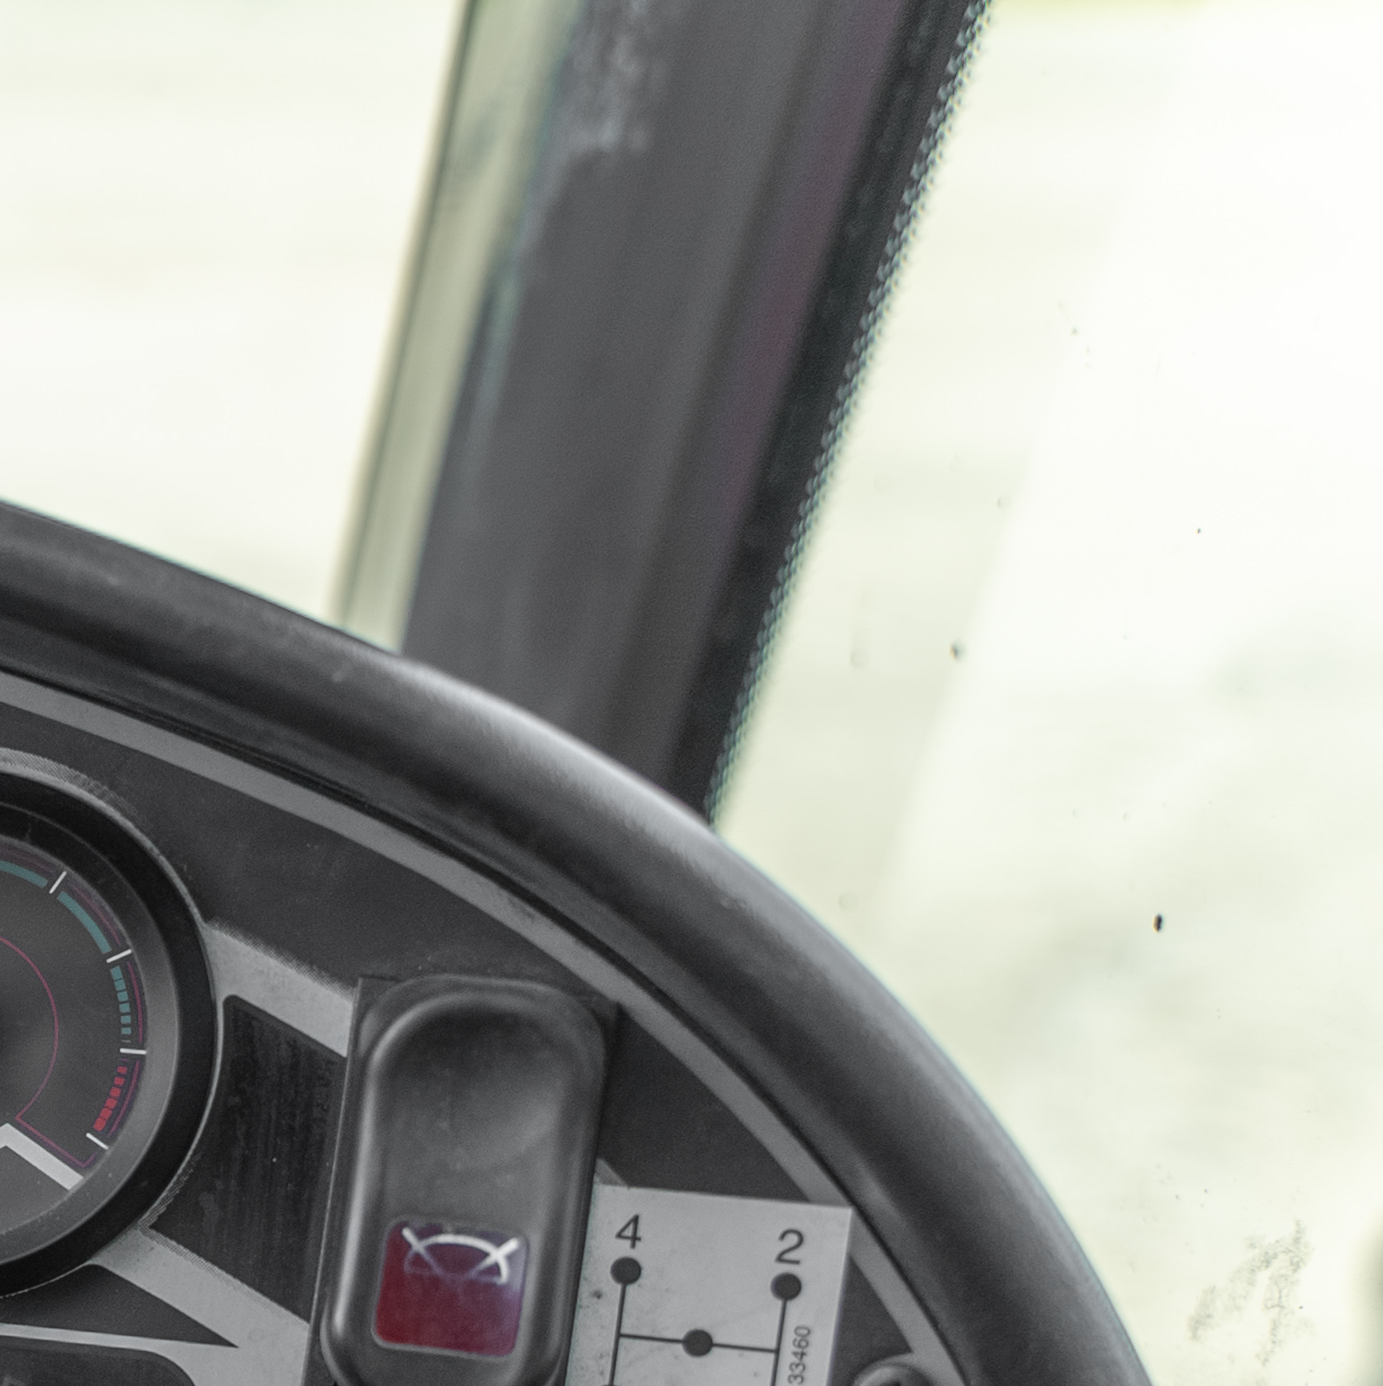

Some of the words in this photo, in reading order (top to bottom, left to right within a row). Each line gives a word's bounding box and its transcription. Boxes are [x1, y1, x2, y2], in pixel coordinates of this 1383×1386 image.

[614, 1214, 643, 1249] 4
[775, 1229, 805, 1265] 2
[787, 1325, 811, 1386] 33460
